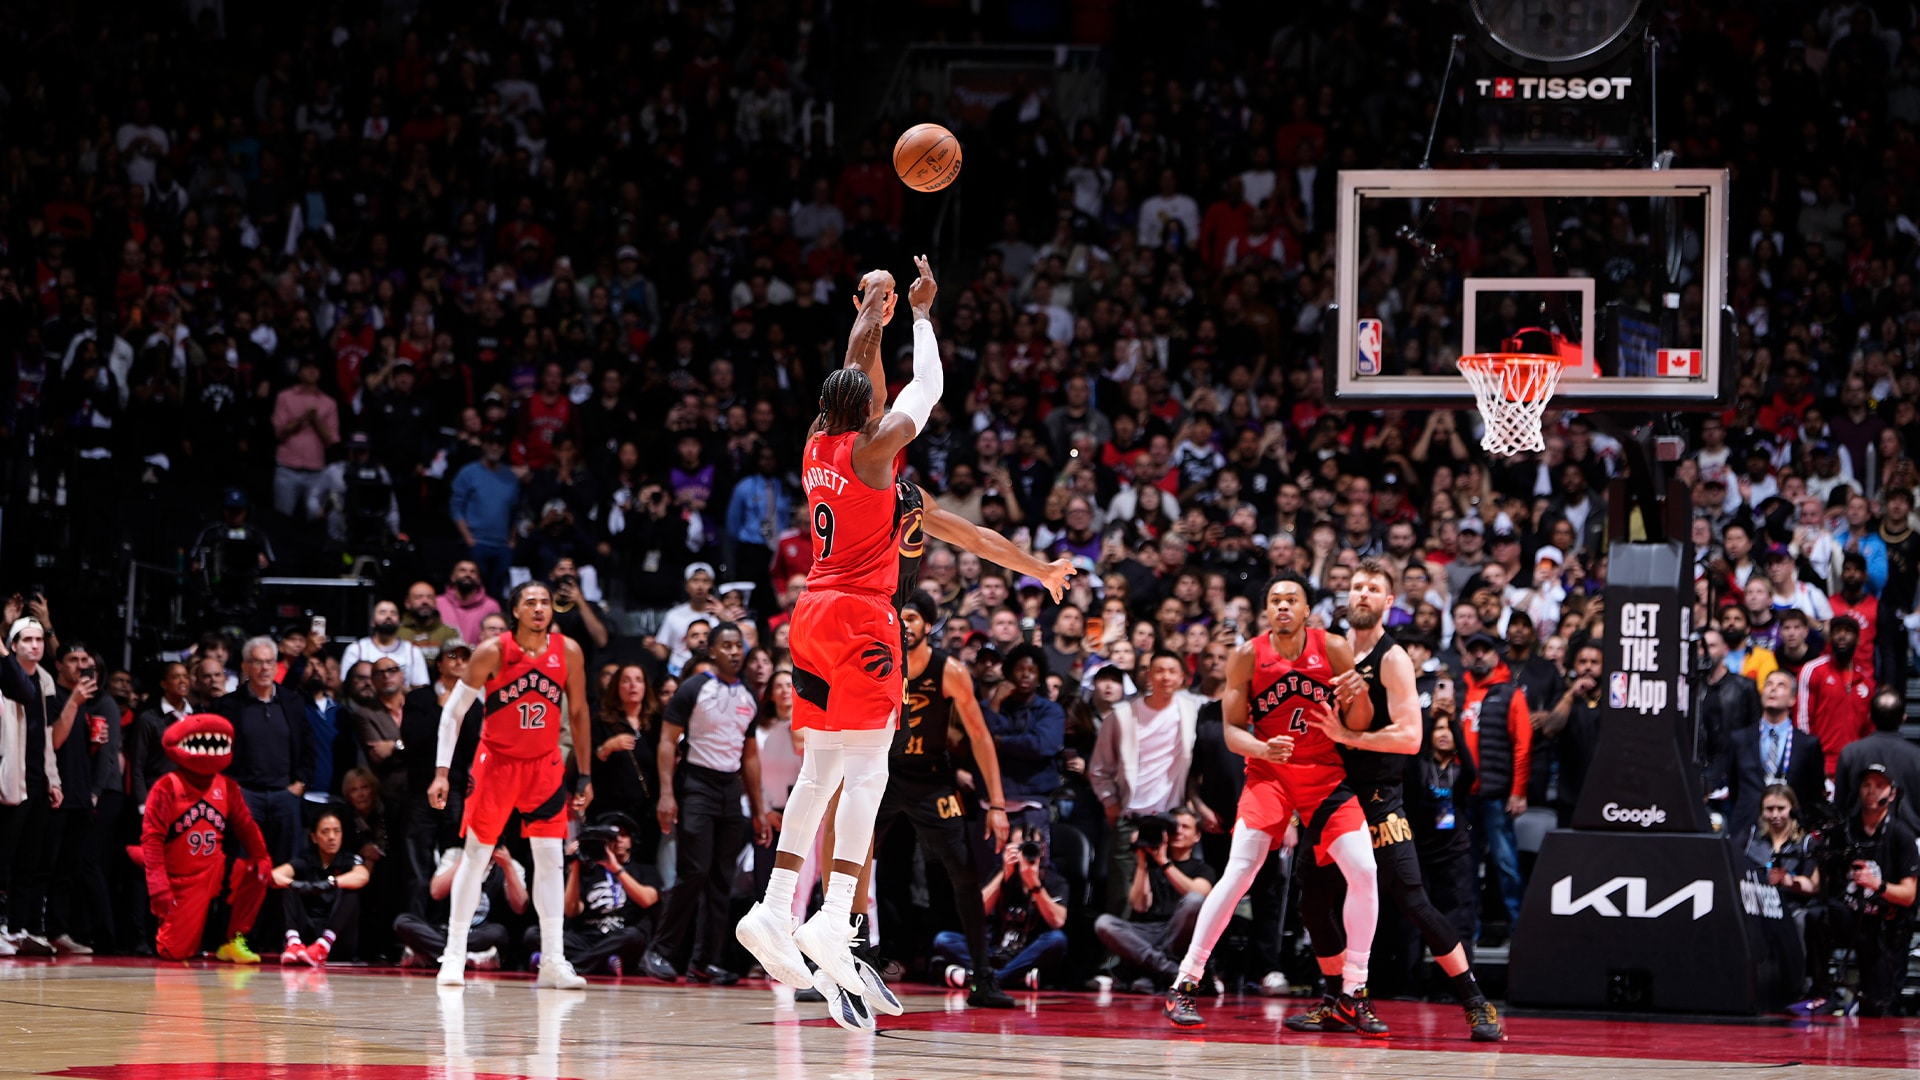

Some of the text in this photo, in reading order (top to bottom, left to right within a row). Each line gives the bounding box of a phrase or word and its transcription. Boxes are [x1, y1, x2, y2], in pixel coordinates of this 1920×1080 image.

[1474, 76, 1633, 101] T TISSOT
[814, 501, 836, 561] 9
[1620, 602, 1661, 638] GET
[1619, 637, 1660, 672] THE
[1258, 676, 1331, 712] RAPTOR
[1626, 672, 1668, 716] App
[517, 701, 547, 729] 12
[1288, 707, 1309, 735] 4
[1368, 814, 1412, 849] CAVS
[1602, 802, 1667, 828] Google
[187, 830, 217, 857] 95
